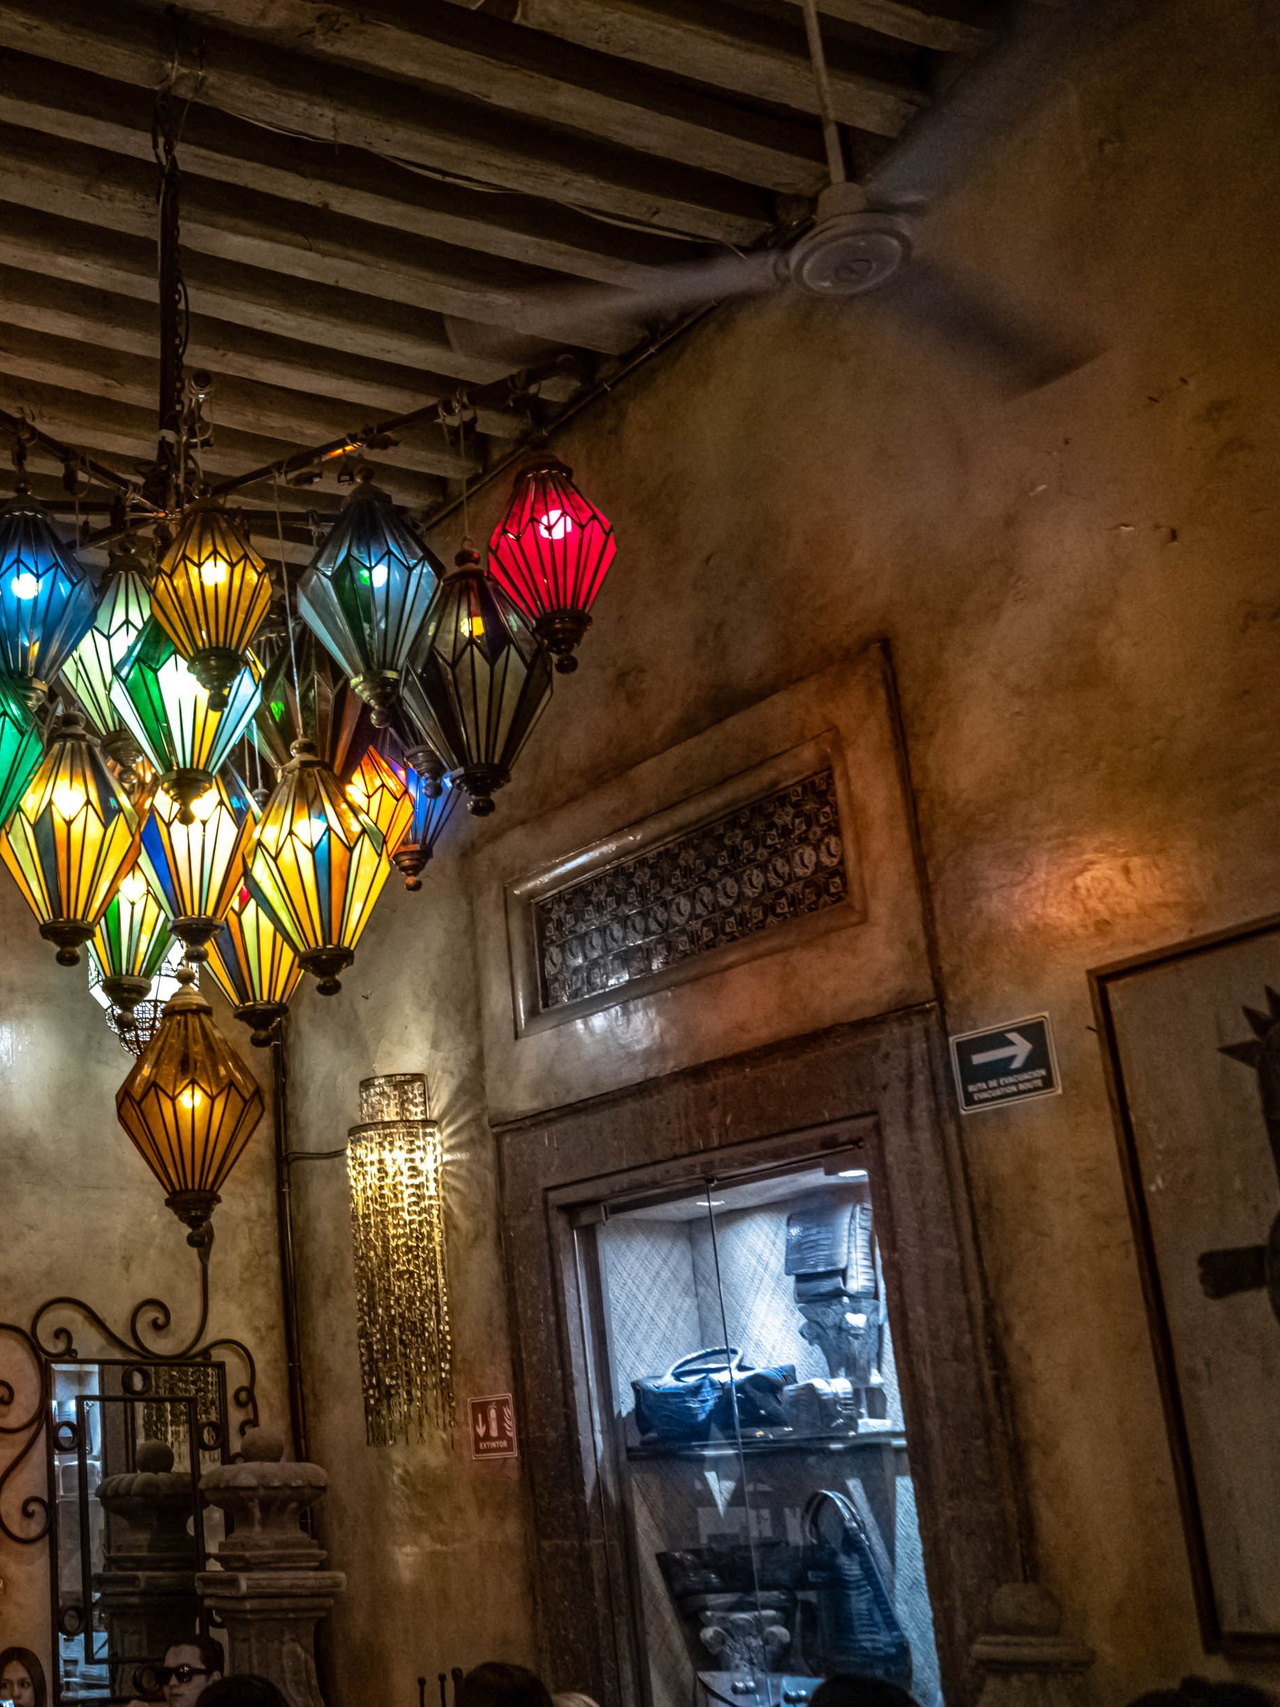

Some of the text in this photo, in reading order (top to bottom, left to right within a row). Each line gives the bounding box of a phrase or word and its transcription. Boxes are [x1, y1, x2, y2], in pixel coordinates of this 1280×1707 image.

[968, 1082, 987, 1092] RUTA
[988, 1080, 998, 1088] DE
[973, 1079, 1043, 1101] EVACUATION ROUTE
[479, 1440, 508, 1449] EXTINTOR
